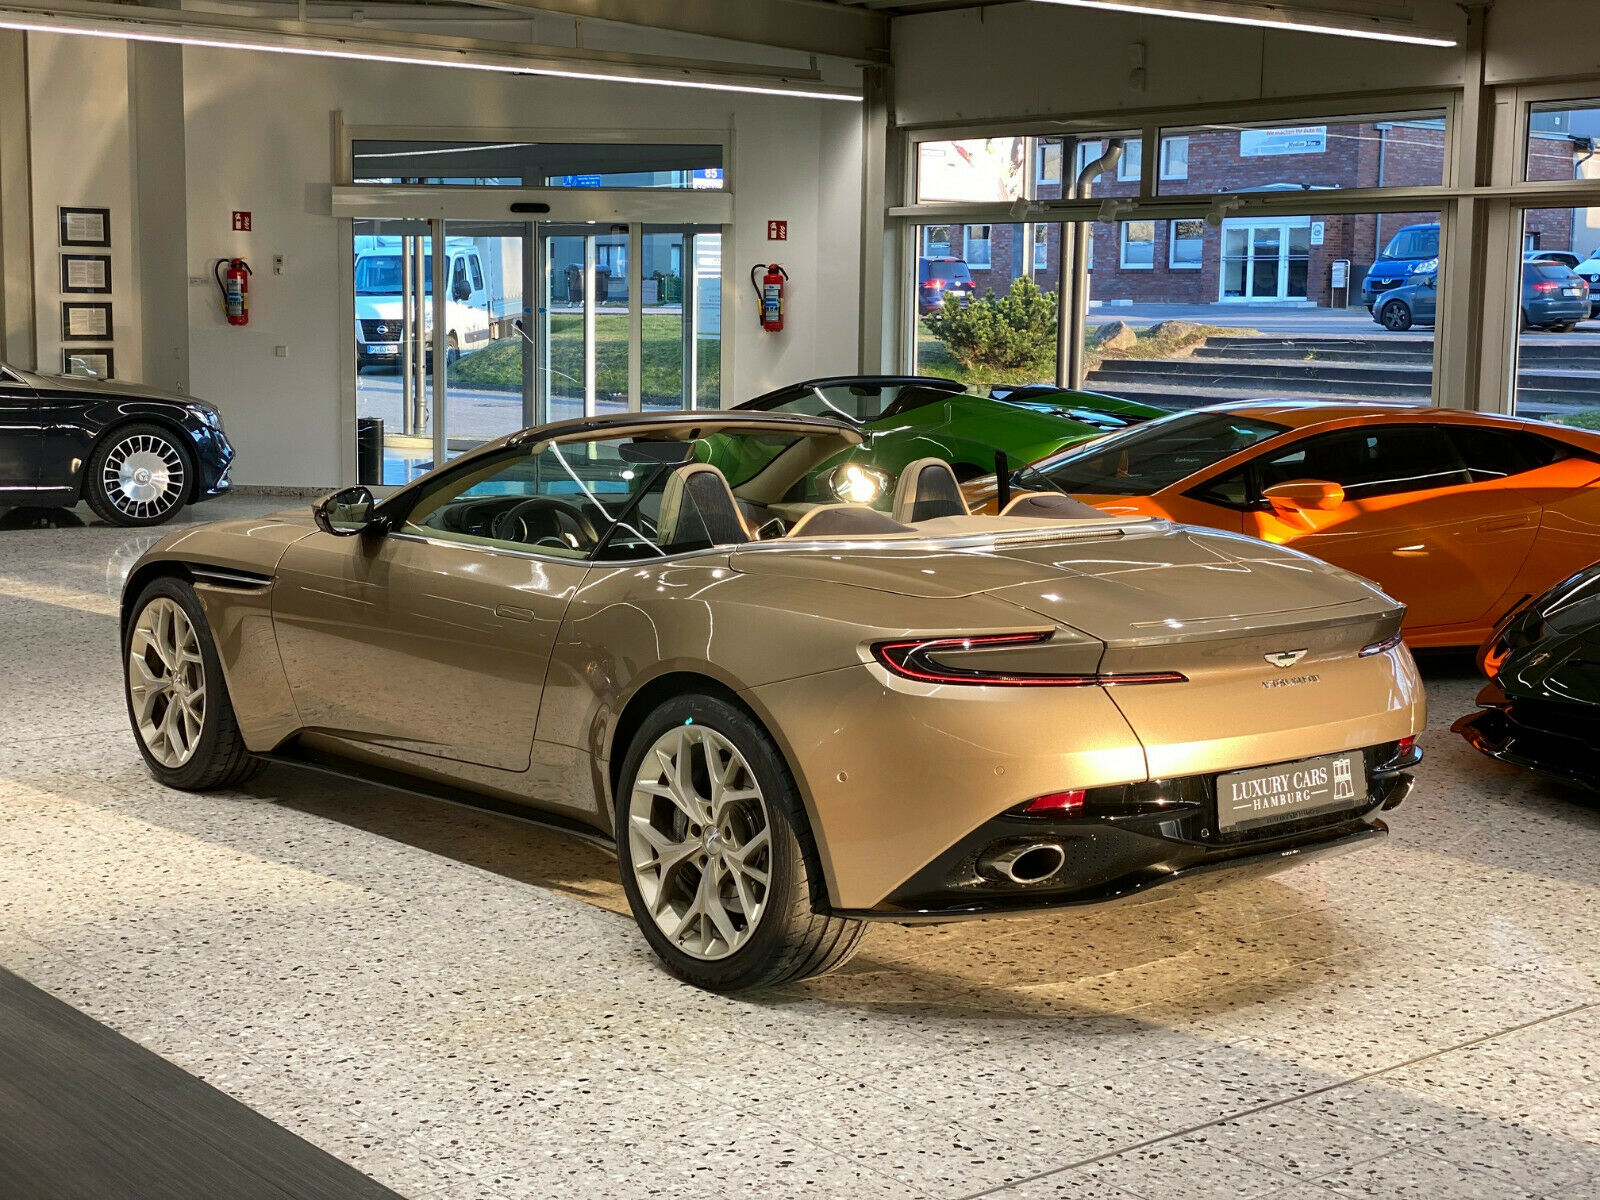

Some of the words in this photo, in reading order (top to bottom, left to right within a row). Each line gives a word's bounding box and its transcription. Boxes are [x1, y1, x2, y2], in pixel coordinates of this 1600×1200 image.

[1231, 773, 1290, 801] LUXURY
[1293, 767, 1328, 789] CARS
[1253, 789, 1311, 811] HAMBURG
